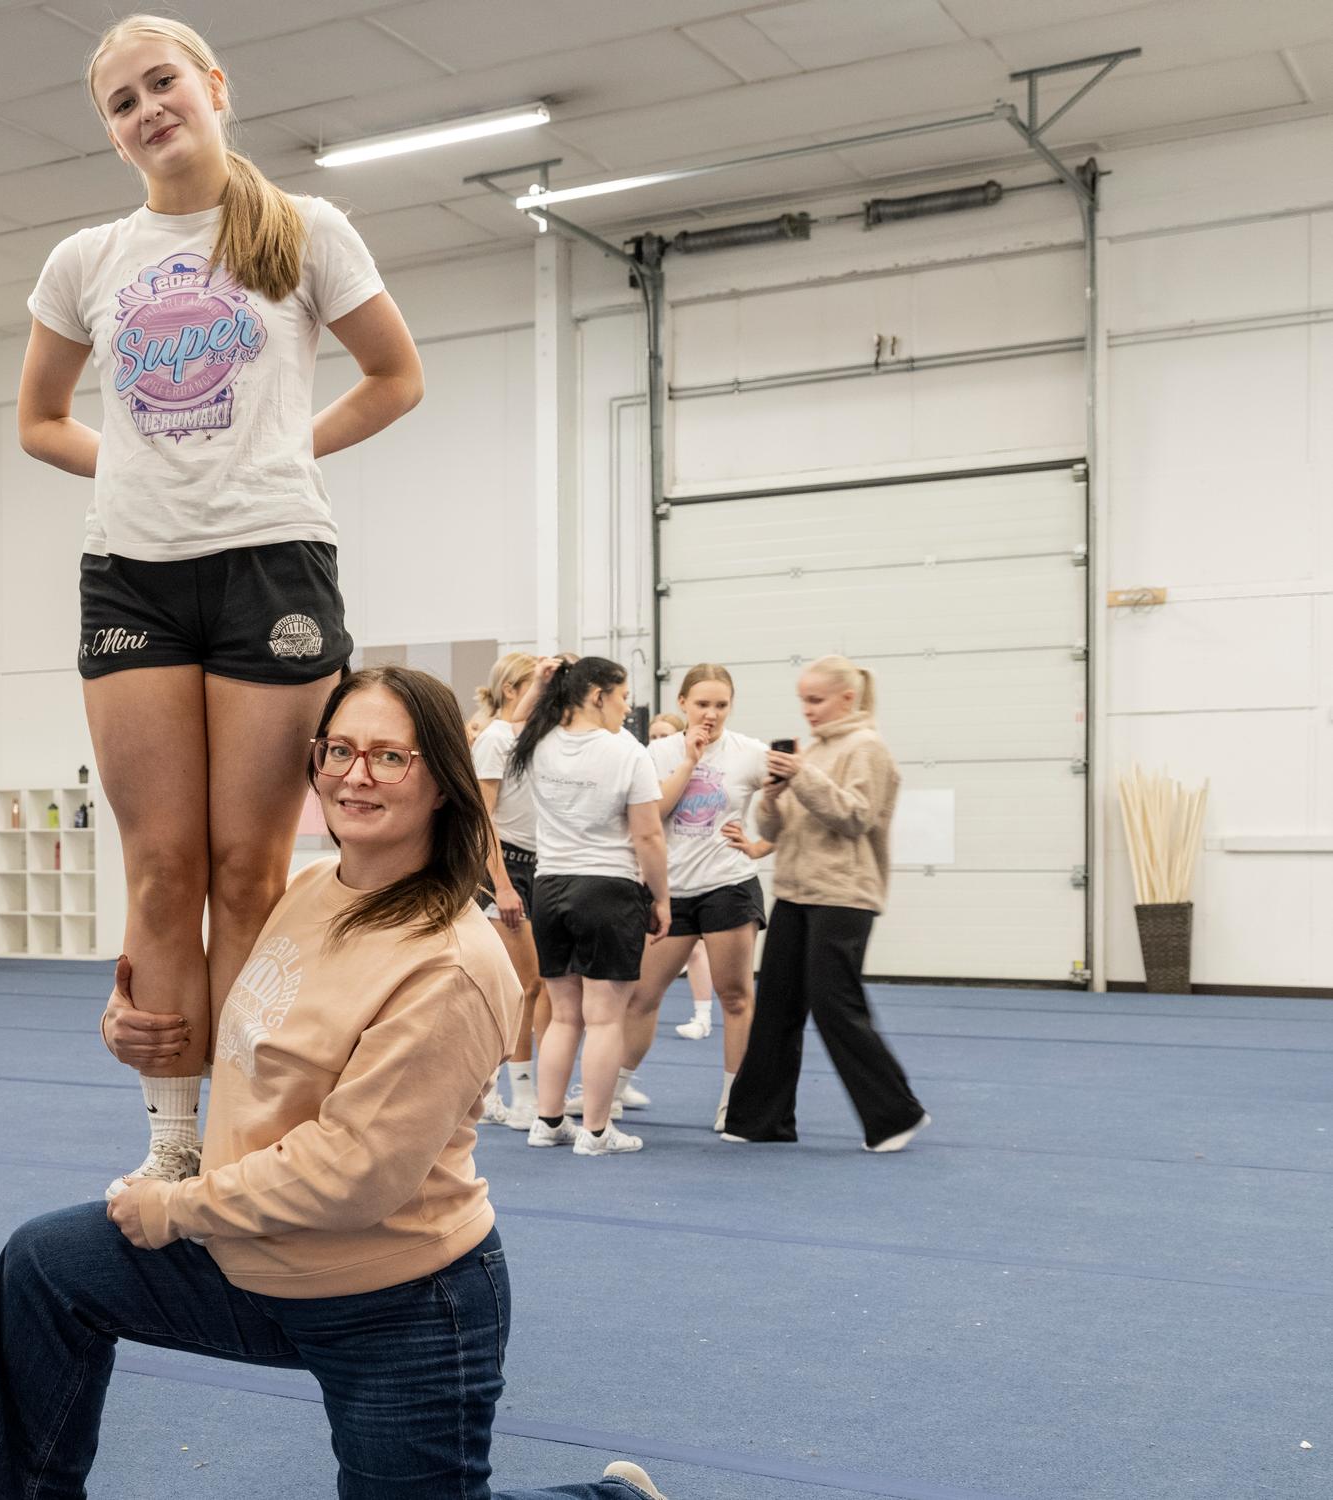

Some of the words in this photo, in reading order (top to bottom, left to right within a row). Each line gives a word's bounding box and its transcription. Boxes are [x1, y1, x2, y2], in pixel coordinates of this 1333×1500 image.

[155, 273, 207, 291] 2024
[137, 294, 222, 326] CHEERLEADING
[114, 308, 262, 392] Super
[205, 348, 260, 367] 3&4&5
[270, 614, 301, 639] NORTHERN
[302, 615, 321, 637] LIGHTS
[91, 627, 149, 657] Mini
[267, 956, 303, 1029] LIGHTS
